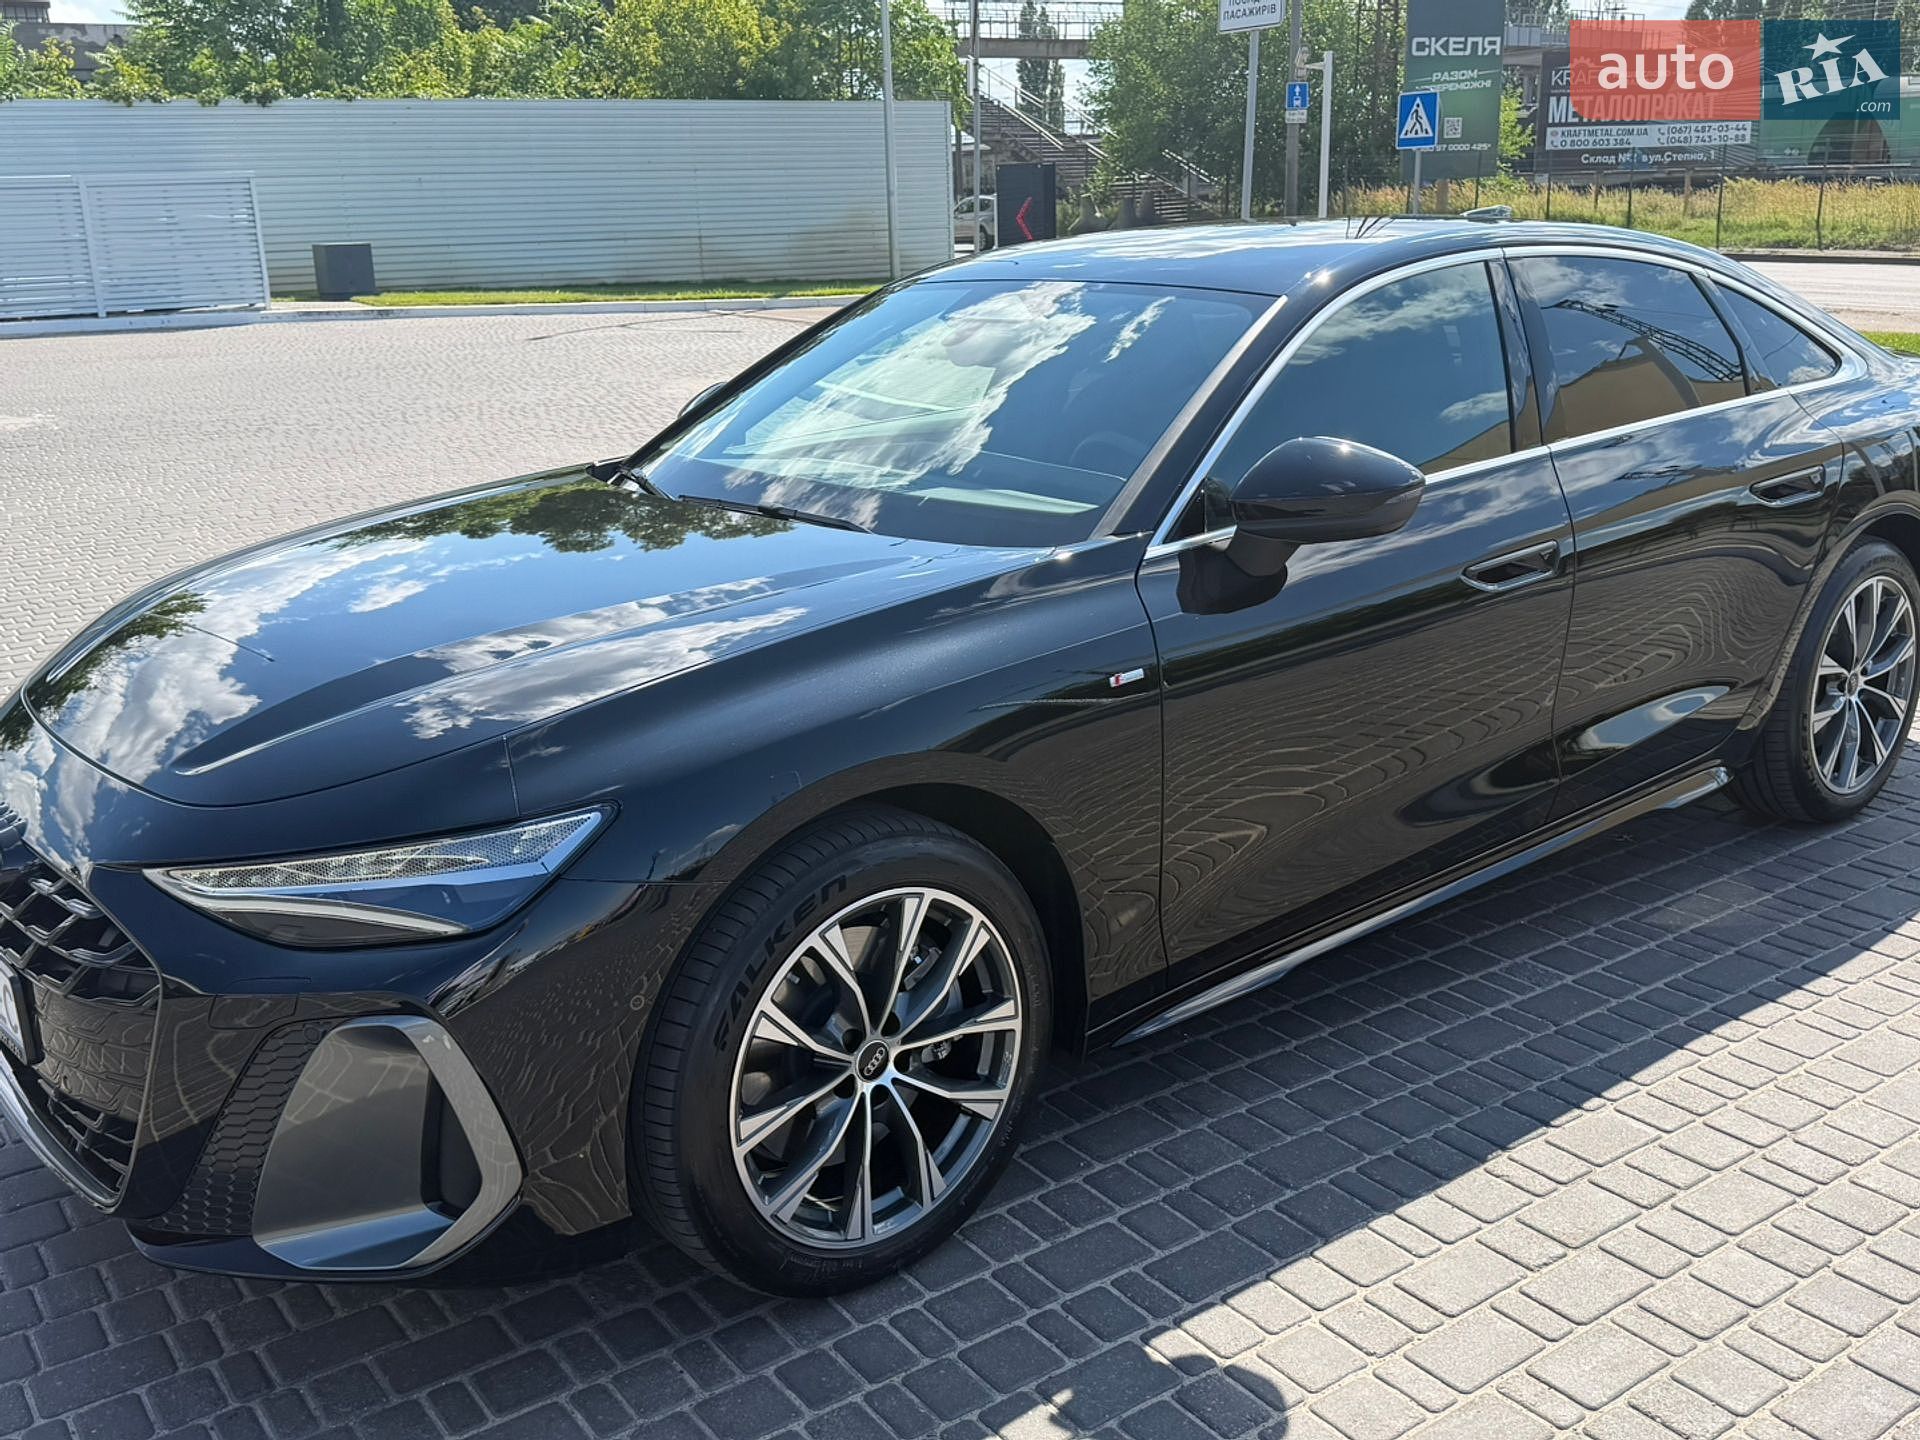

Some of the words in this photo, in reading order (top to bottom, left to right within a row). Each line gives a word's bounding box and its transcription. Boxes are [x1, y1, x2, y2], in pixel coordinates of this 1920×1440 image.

[1222, 3, 1277, 21] ПАСАЖИРІВ
[1411, 36, 1502, 57] СКЕЛЯ
[1432, 69, 1479, 82] РАЗОМ
[1549, 94, 1715, 123] МЕТАЛОПРОКАТ
[1560, 128, 1649, 138] KRAFTMETAL.COM.UA
[1581, 153, 1616, 164] Склад
